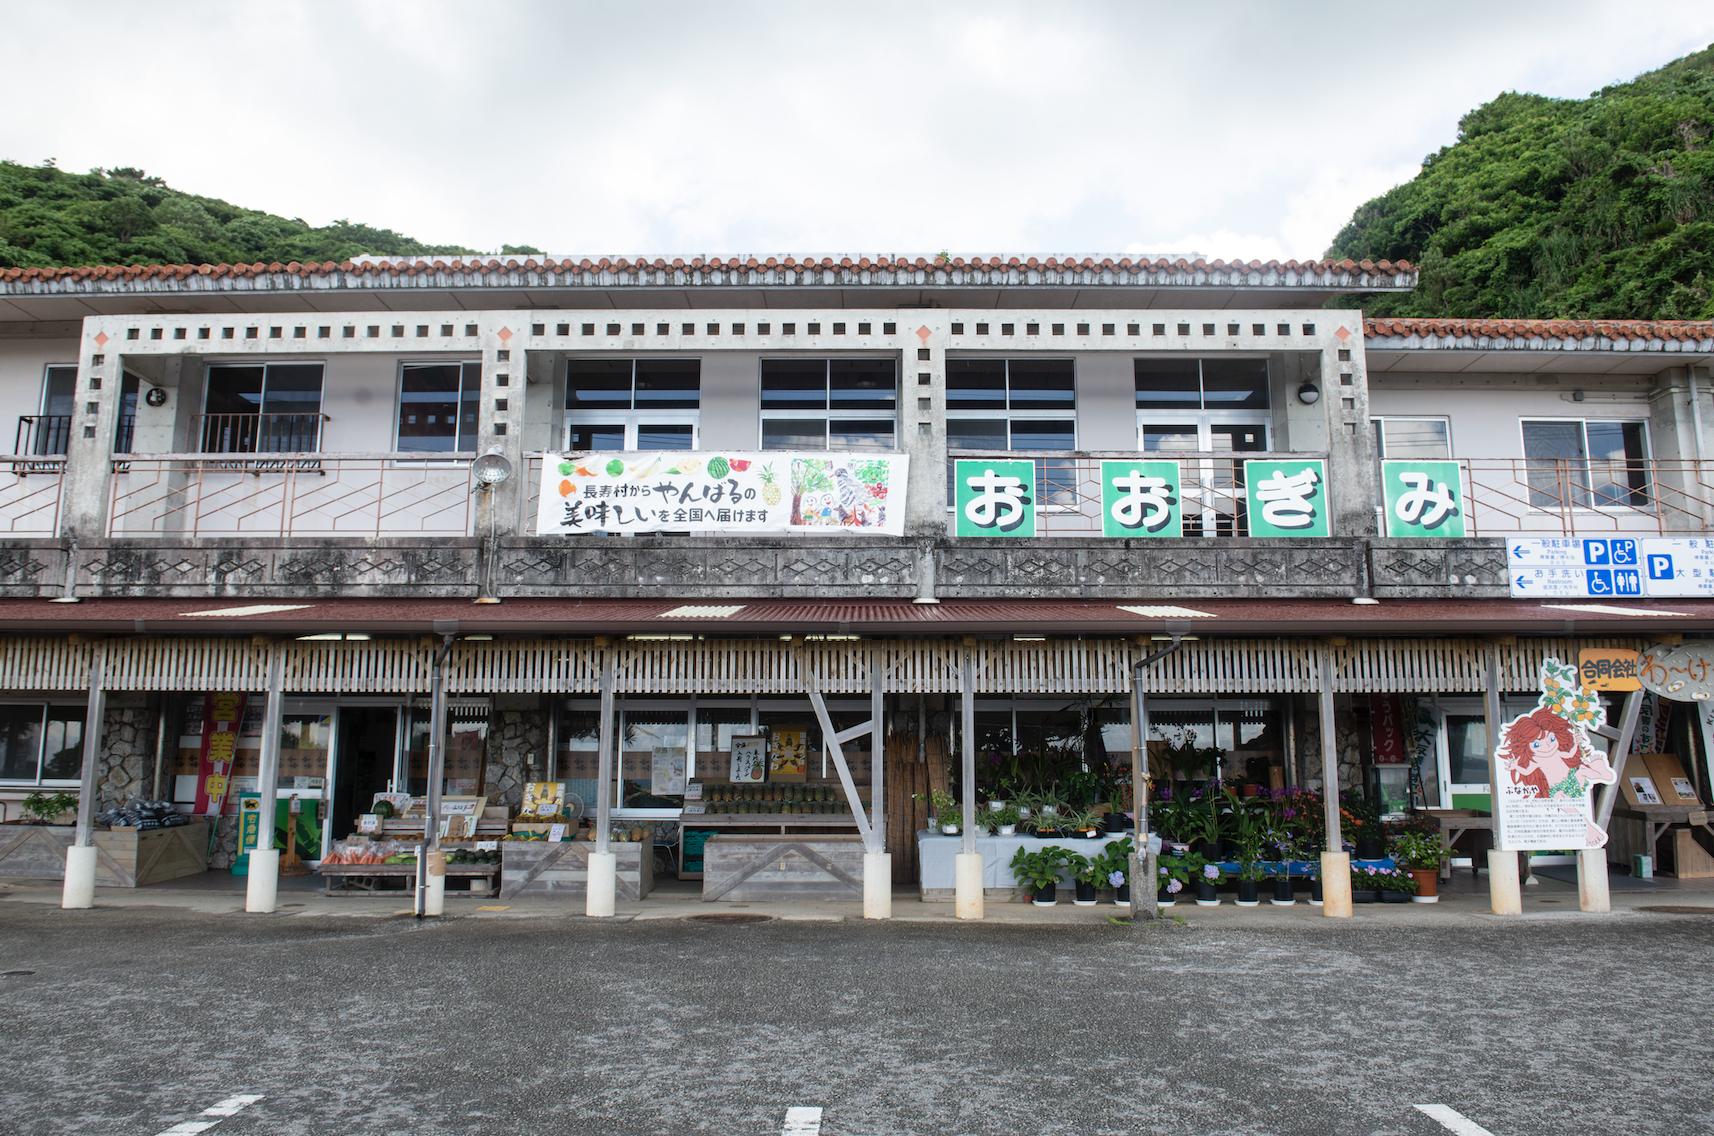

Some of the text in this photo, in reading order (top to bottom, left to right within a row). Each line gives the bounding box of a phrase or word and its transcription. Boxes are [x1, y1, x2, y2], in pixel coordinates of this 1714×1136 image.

[583, 479, 756, 504] 長寿村からやんばるの
[964, 467, 1456, 528] お お ぎ み
[561, 501, 768, 527] 美味しいを全国へ届けます
[1588, 542, 1605, 562] P
[1535, 569, 1584, 578] お手洗い
[1653, 557, 1669, 577] P
[1582, 659, 1637, 679] 合同会社
[1382, 695, 1395, 752] うパック
[207, 692, 242, 802] 営業中
